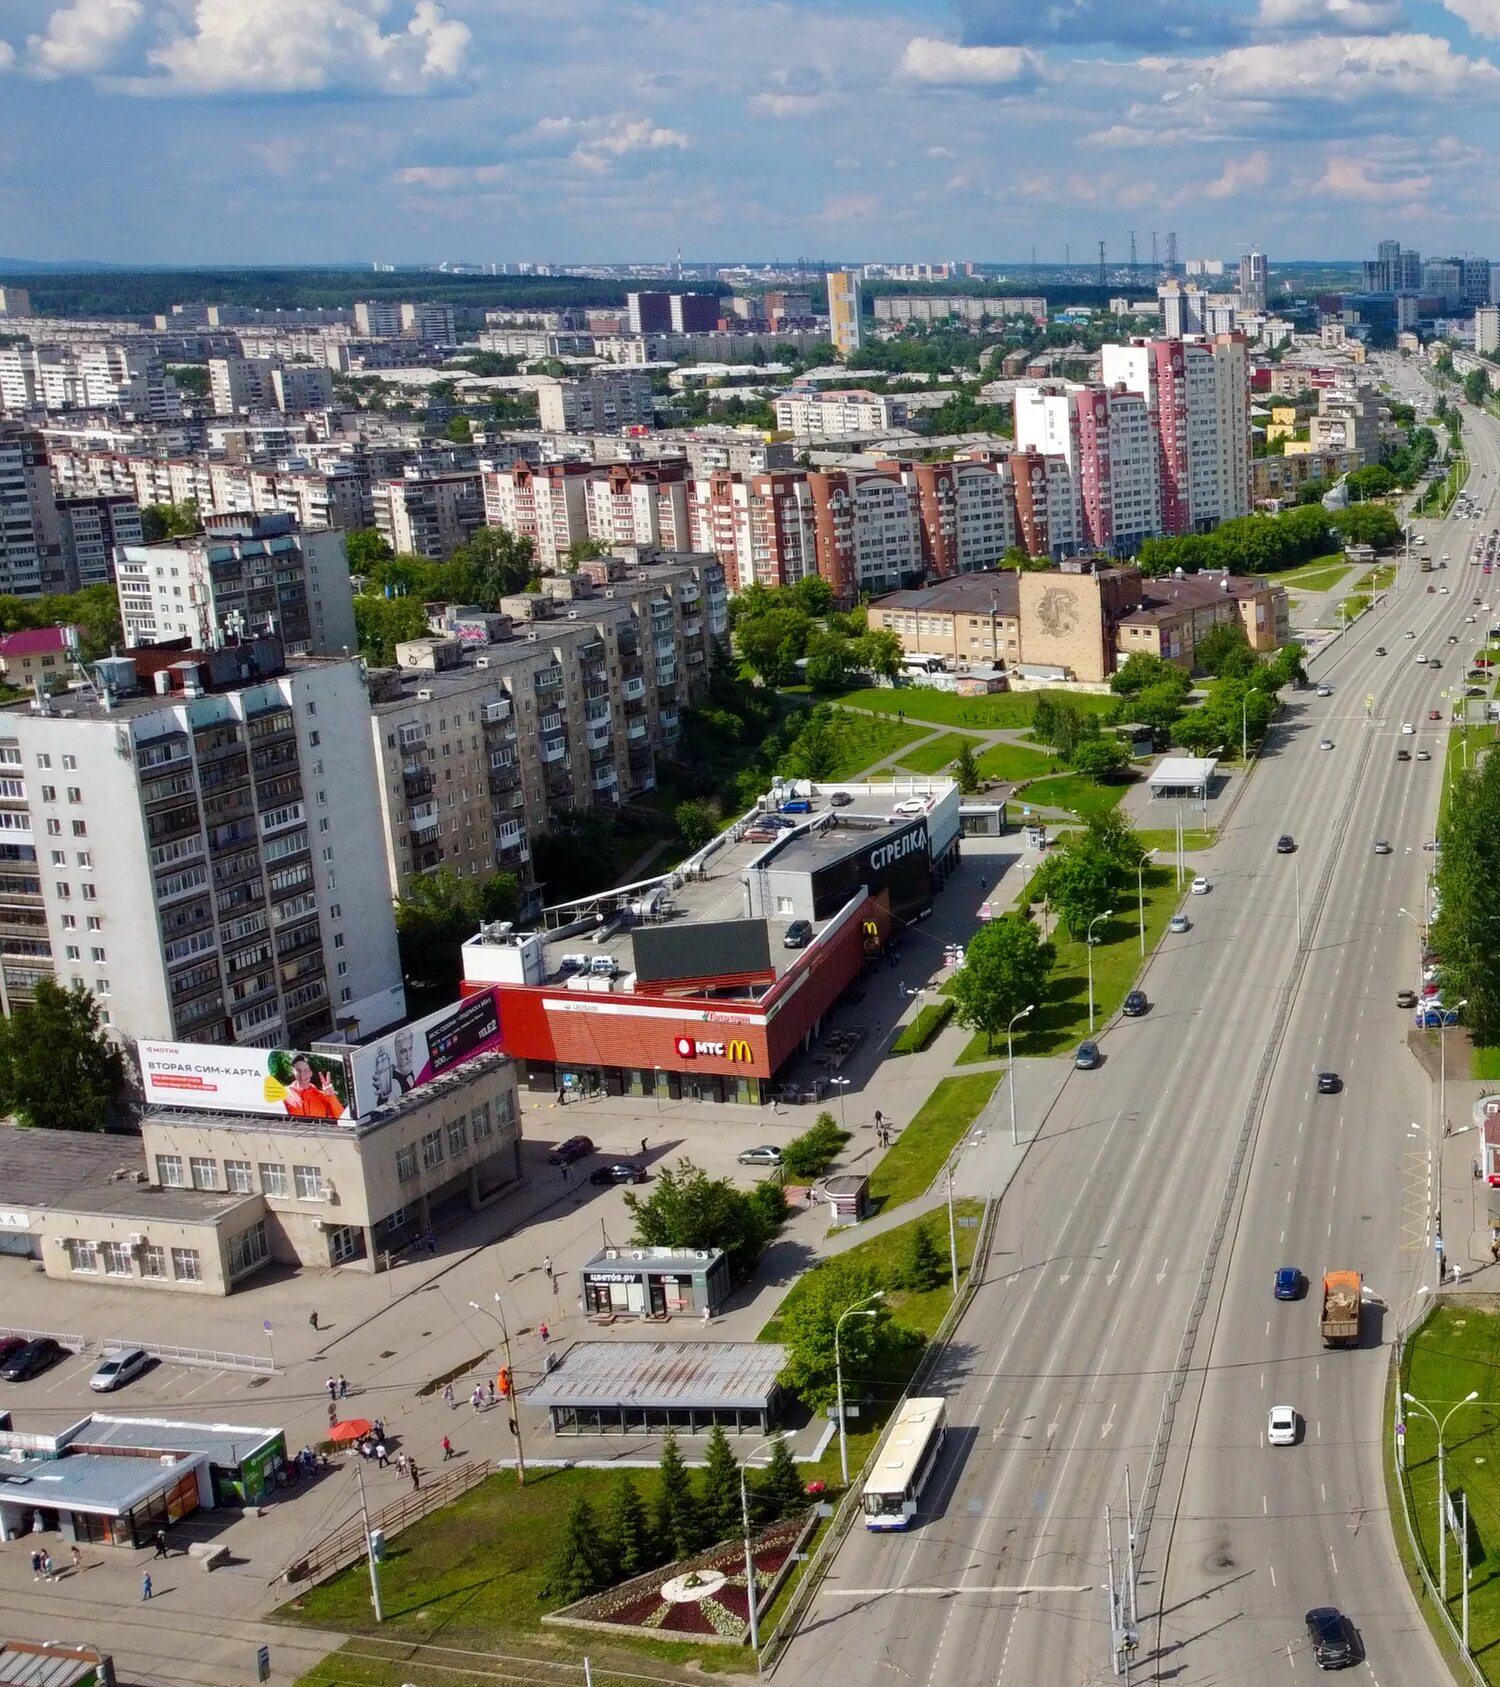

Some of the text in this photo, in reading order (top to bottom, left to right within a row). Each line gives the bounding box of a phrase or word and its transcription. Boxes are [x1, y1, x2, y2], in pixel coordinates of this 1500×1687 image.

[871, 826, 927, 871] СТРЕЛКА
[478, 1019, 498, 1039] TELE2
[695, 1041, 724, 1055] МТС
[148, 1061, 261, 1077] ВТОРАЯ СИМ-КАРТА
